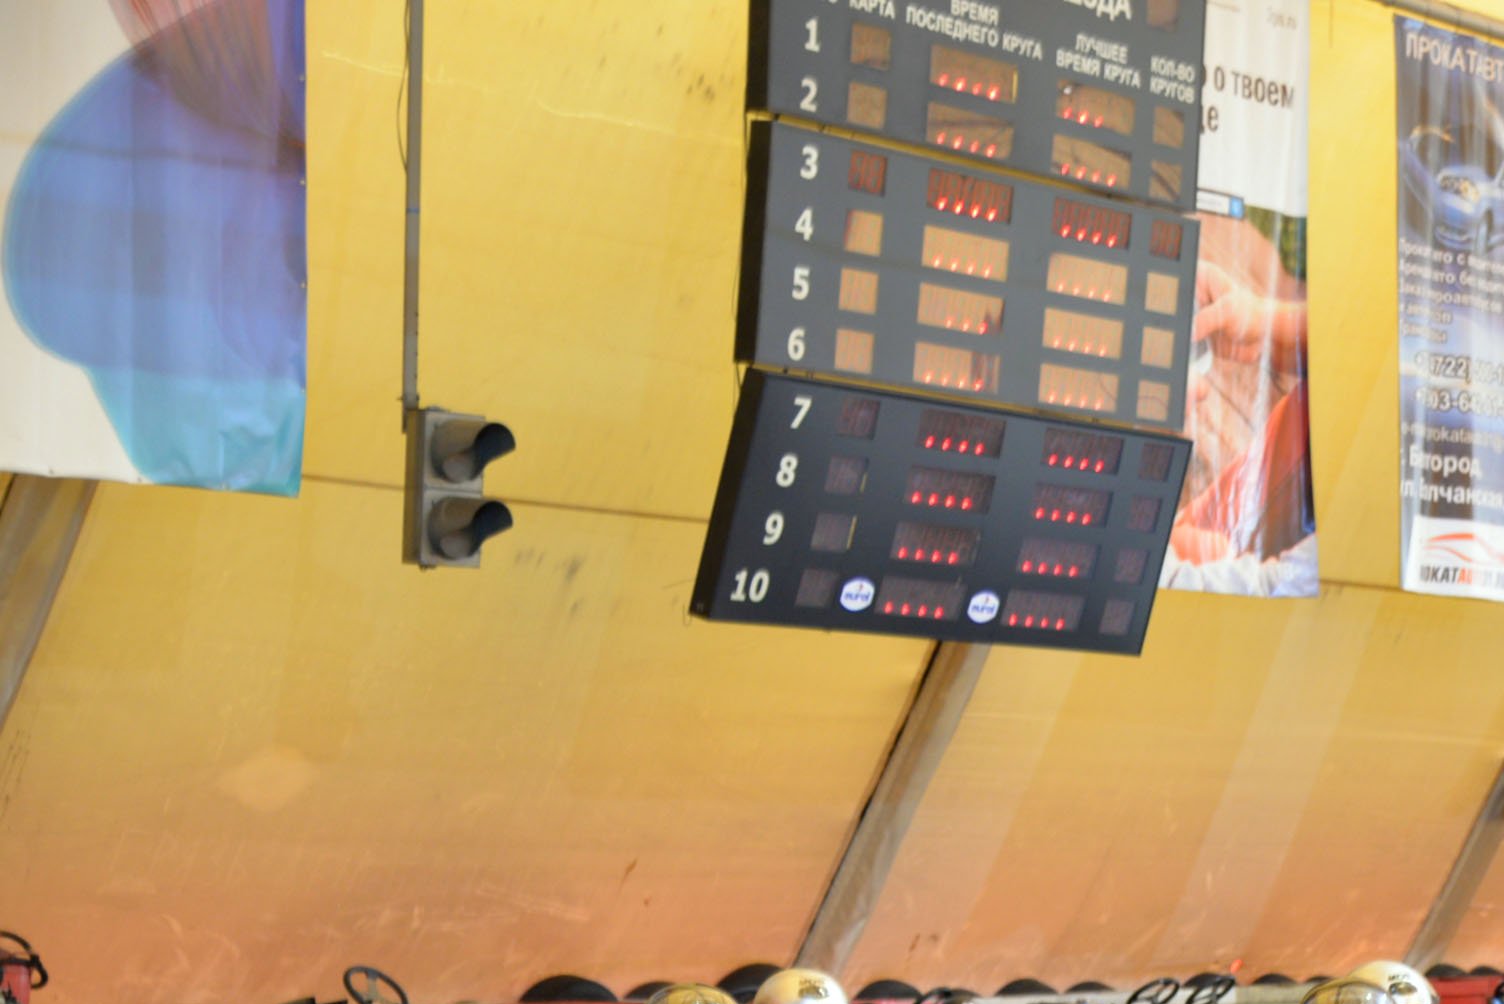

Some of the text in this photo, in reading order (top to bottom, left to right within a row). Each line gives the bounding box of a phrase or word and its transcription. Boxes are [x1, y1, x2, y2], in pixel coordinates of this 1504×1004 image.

[849, 0, 896, 19] КАРТА
[950, 0, 998, 26] ВРЕМЯ
[804, 18, 821, 53] 1
[906, 5, 1043, 61] ПОСЛЕДНЕГО КРУГА
[1076, 33, 1128, 65] ЛУЧШЕЕ
[1056, 49, 1142, 89] ВРЕМЯ КРУГА
[1151, 55, 1196, 82] КОЛ-ВО
[800, 77, 818, 112] 2
[1150, 76, 1195, 105] КРУГОВ
[800, 145, 819, 180] 3
[795, 208, 814, 241] 4
[791, 267, 810, 301] 5
[787, 327, 805, 361] 6
[790, 396, 812, 430] 7
[776, 453, 799, 488] 8
[763, 511, 785, 546] 9
[731, 568, 769, 604] 10
